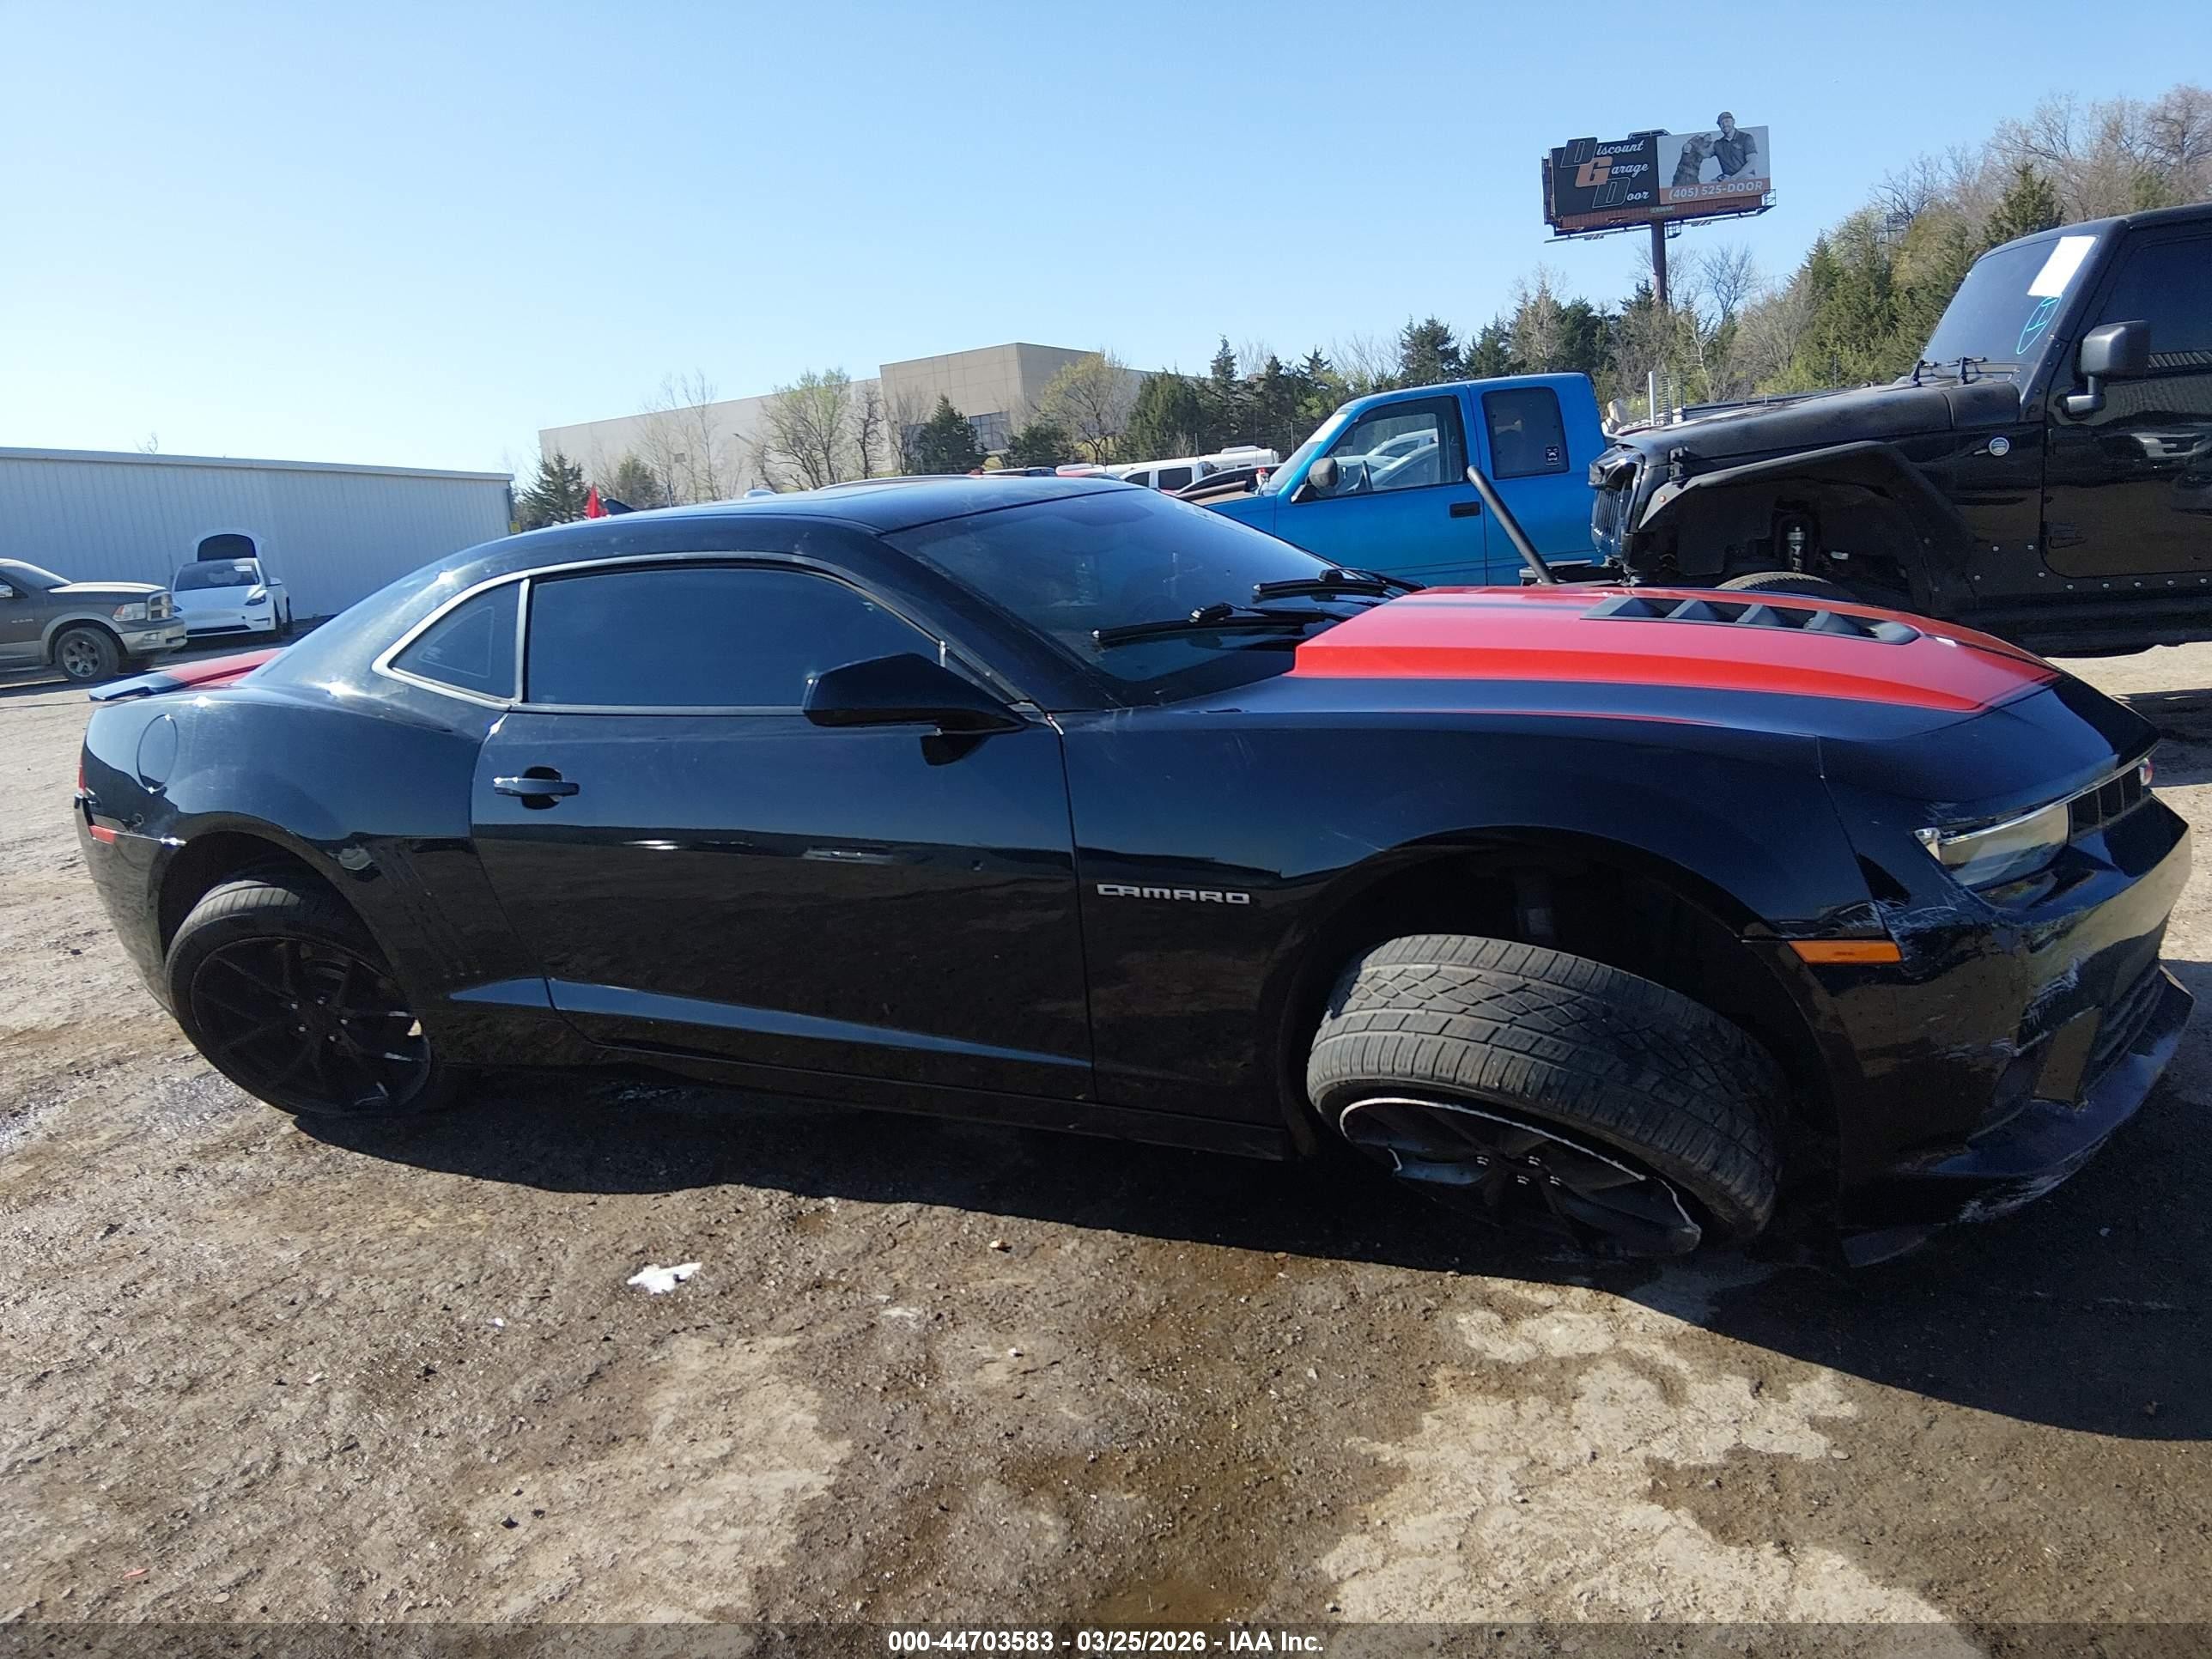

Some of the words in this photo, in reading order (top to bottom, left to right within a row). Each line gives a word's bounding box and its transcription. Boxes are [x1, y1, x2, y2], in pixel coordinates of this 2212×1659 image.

[1559, 137, 1644, 168] Discount
[1575, 156, 1650, 187] Garage
[1592, 177, 1650, 209] Door
[1668, 186, 1698, 201] (405)
[1701, 180, 1764, 196] 525-DOOR
[1097, 884, 1250, 905] CAMARO
